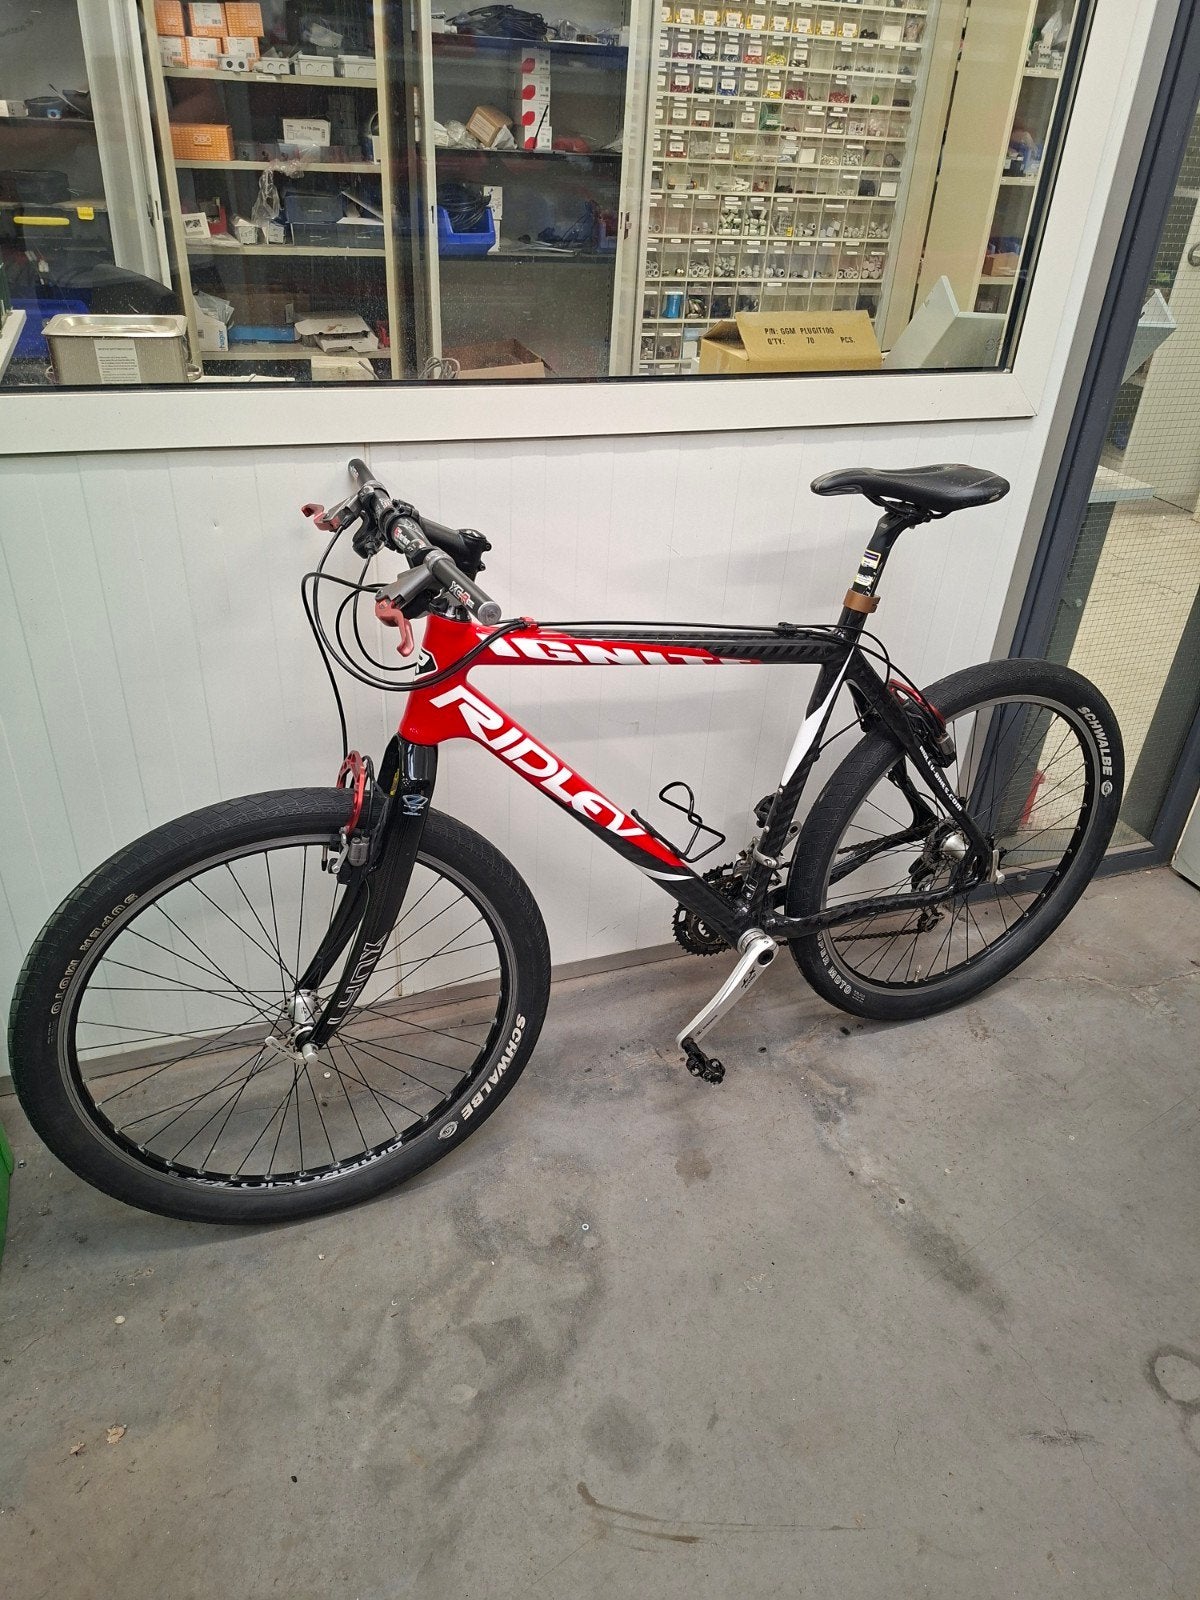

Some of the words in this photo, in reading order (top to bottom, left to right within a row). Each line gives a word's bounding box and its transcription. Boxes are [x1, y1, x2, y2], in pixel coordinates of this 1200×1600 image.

[764, 327, 779, 335] P/N:
[780, 327, 796, 335] GGM
[806, 336, 815, 345] 70
[430, 684, 647, 837] RIDLEY
[1077, 706, 1113, 776] SCHWALBE
[51, 959, 80, 1015] MOTO
[461, 1013, 526, 1121] SCHWALBE
